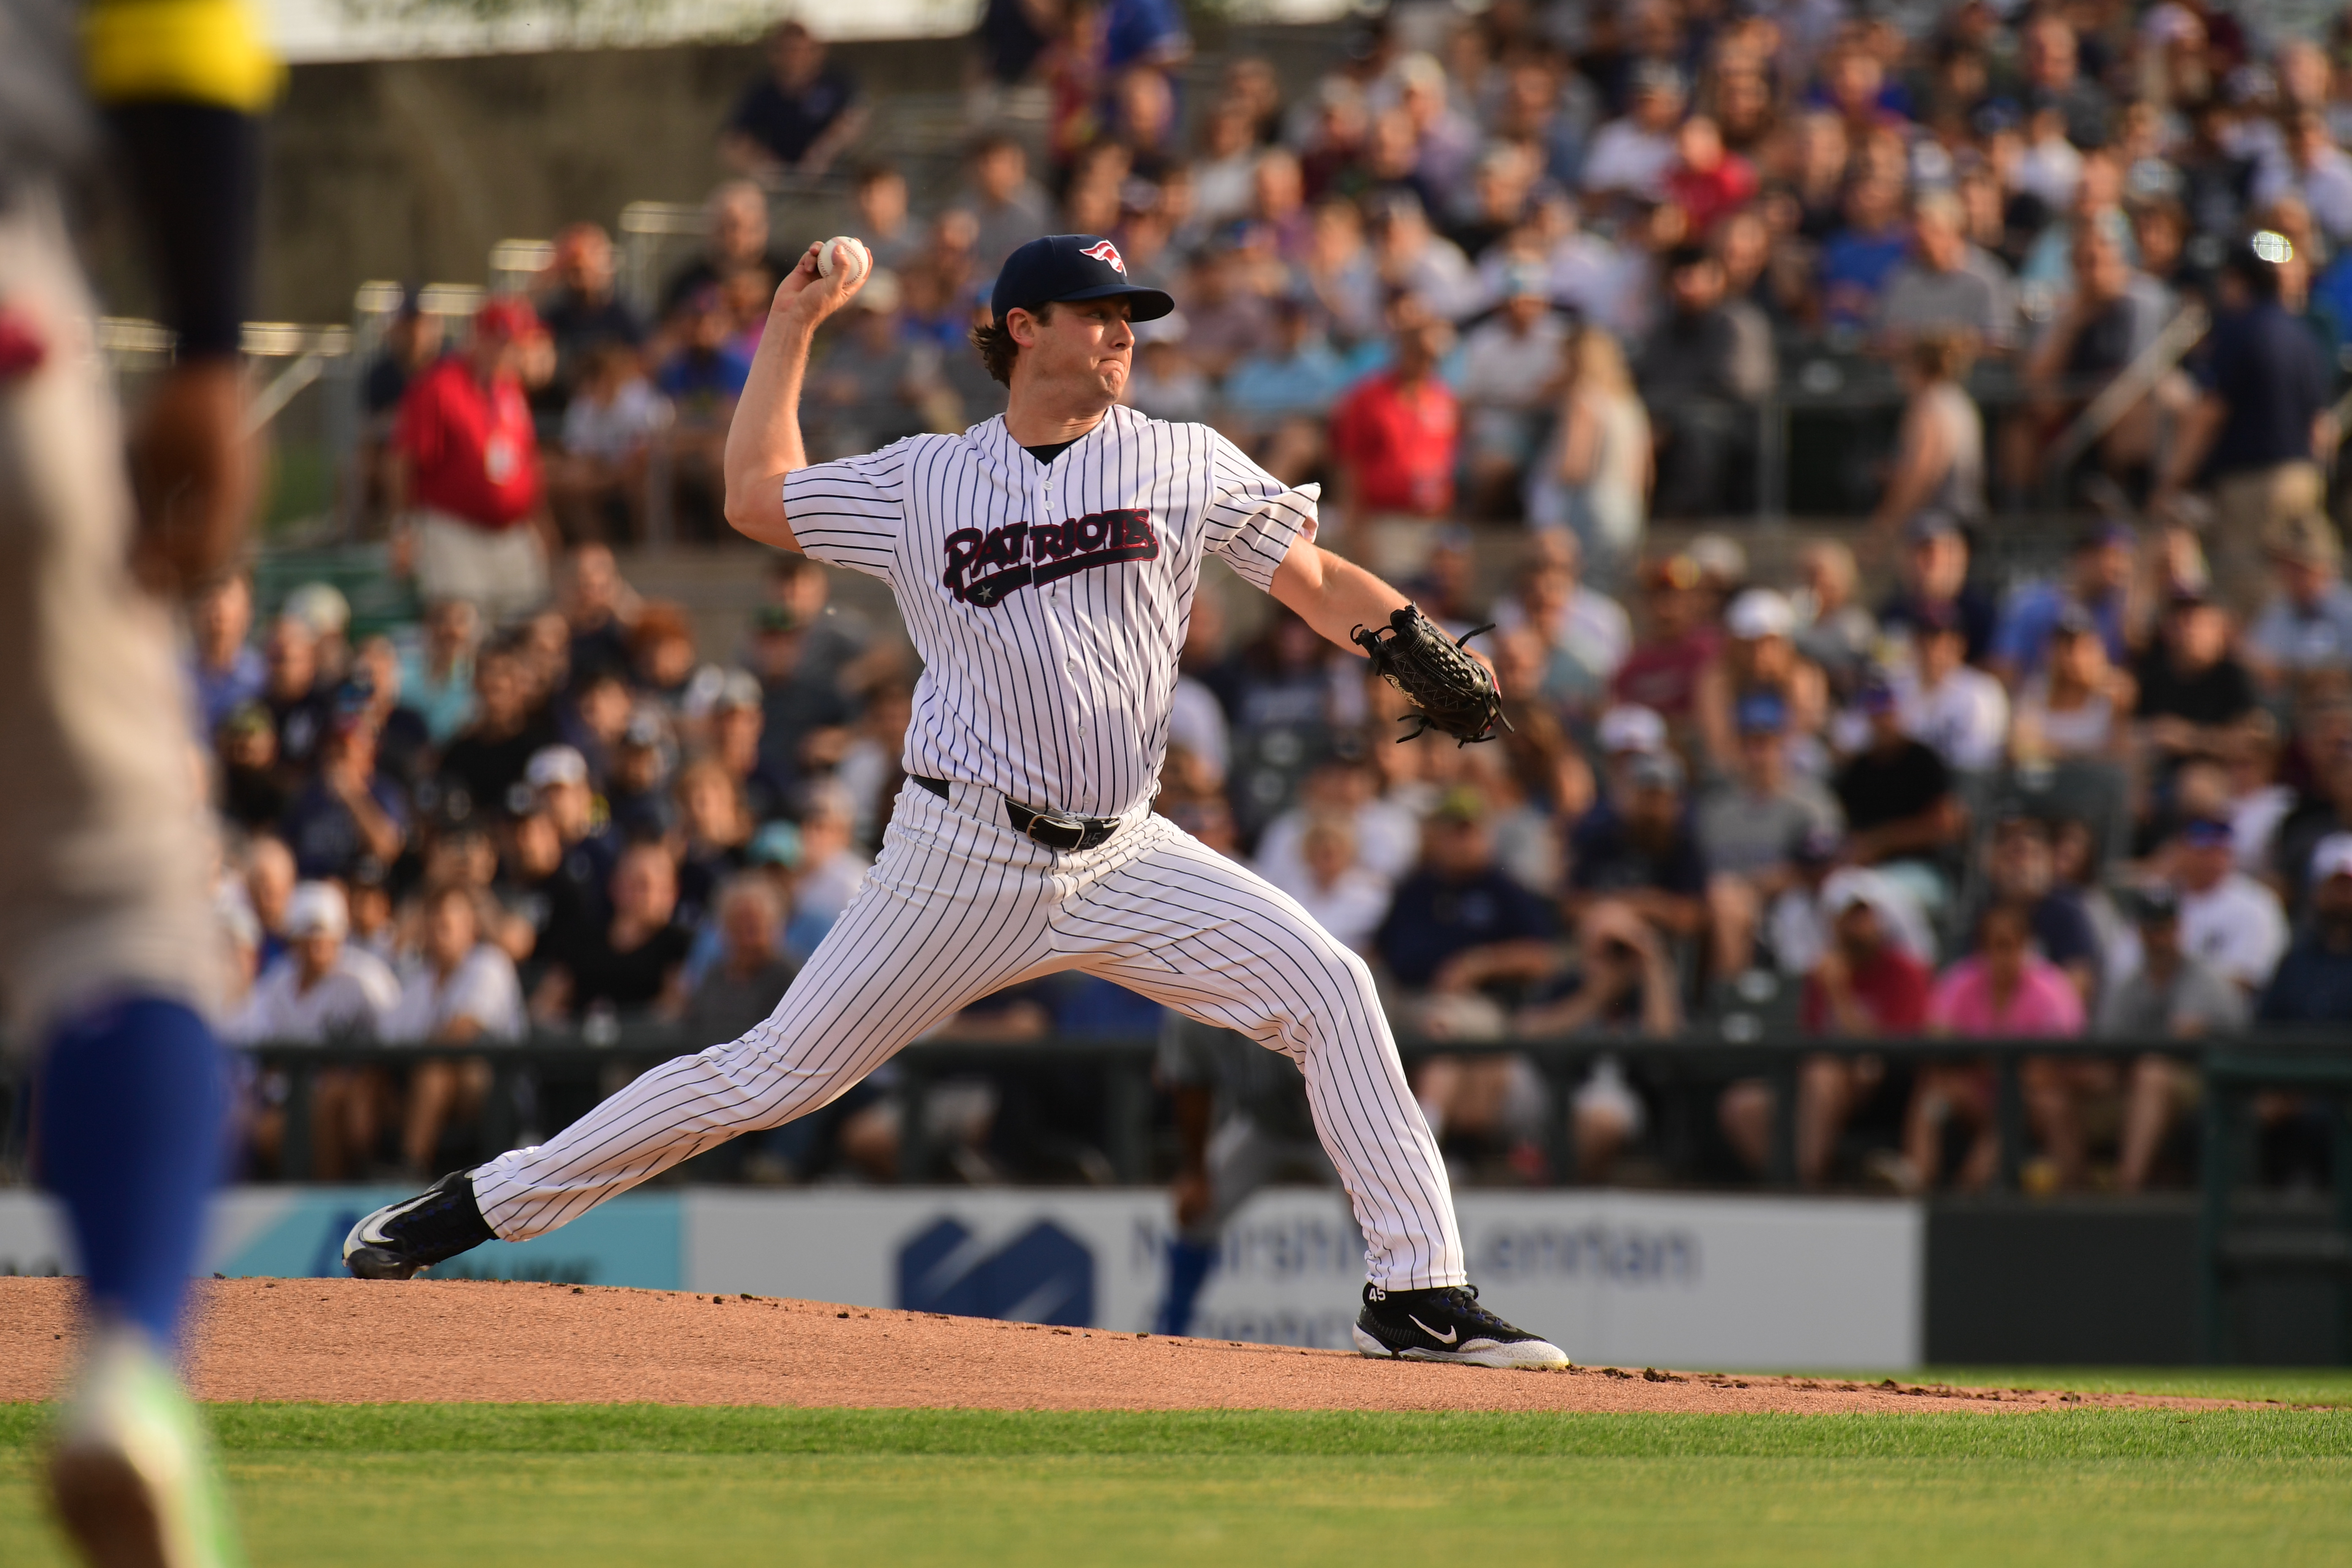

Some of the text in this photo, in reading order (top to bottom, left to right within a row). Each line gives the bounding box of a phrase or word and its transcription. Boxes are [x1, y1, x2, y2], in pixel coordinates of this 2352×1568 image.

[943, 508, 1158, 604] PATRIOTS
[1385, 674, 1426, 709] Rawlings
[1081, 832, 1101, 847] 45
[1369, 1288, 1386, 1302] 45
